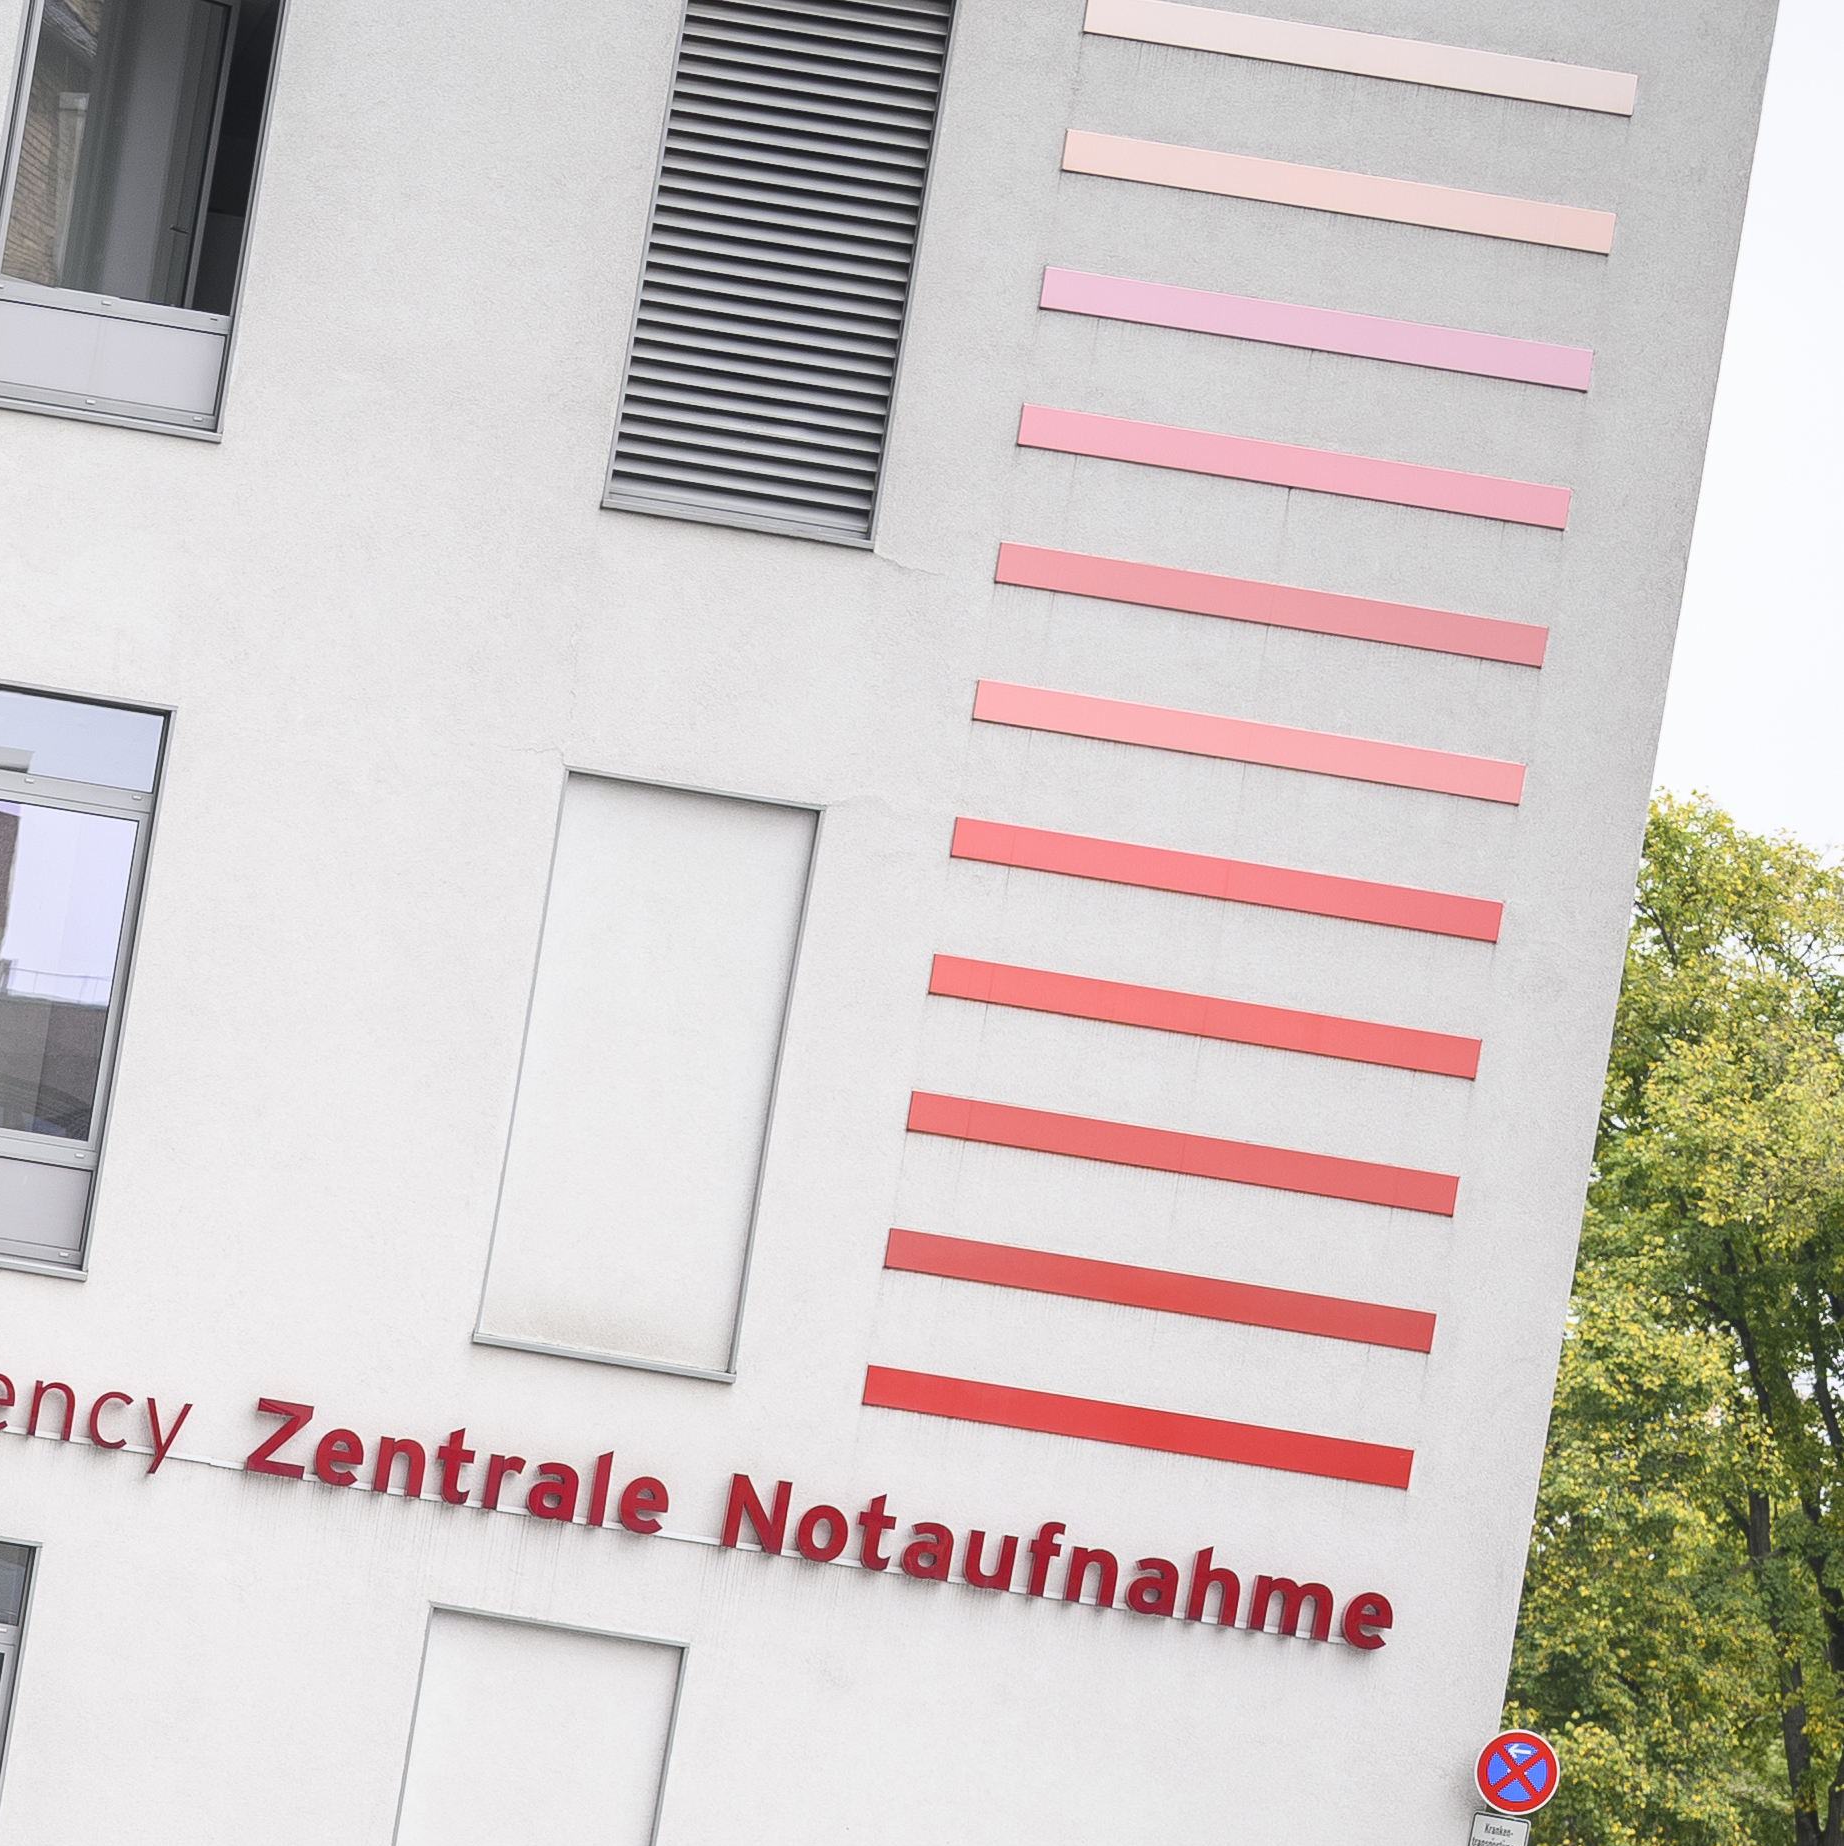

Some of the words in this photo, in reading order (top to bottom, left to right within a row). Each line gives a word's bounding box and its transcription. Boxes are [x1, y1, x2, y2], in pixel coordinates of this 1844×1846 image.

[244, 1396, 670, 1536] Zentrale
[719, 1473, 1395, 1652] Notaufnahme
[1484, 1822, 1514, 1838] Kranken-
